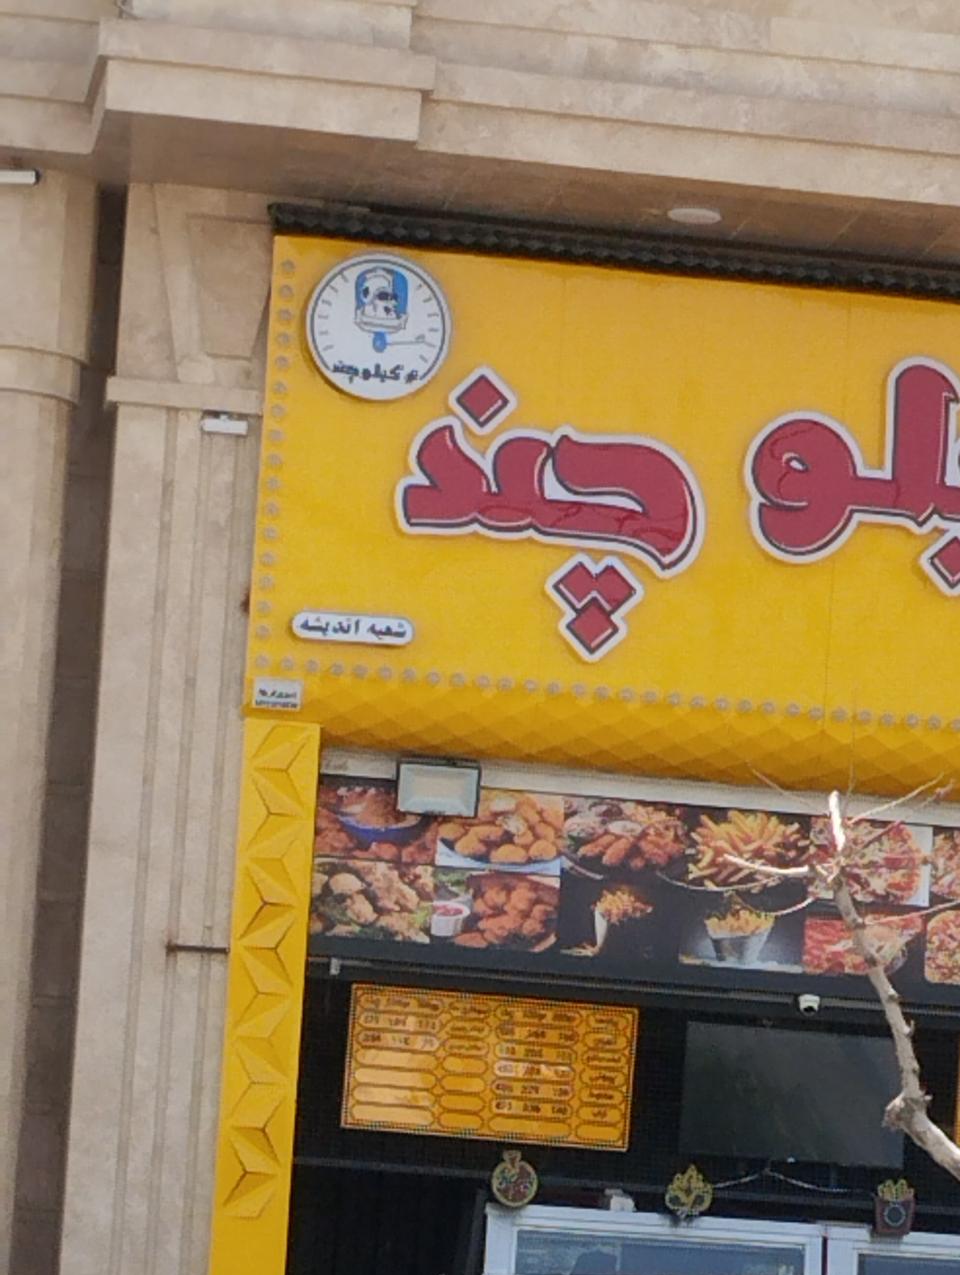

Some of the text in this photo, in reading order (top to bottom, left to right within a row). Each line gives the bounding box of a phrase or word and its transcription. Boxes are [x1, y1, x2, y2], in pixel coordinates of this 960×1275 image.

[398, 369, 700, 659] چند
[298, 616, 407, 640] شعبه اندیشه
